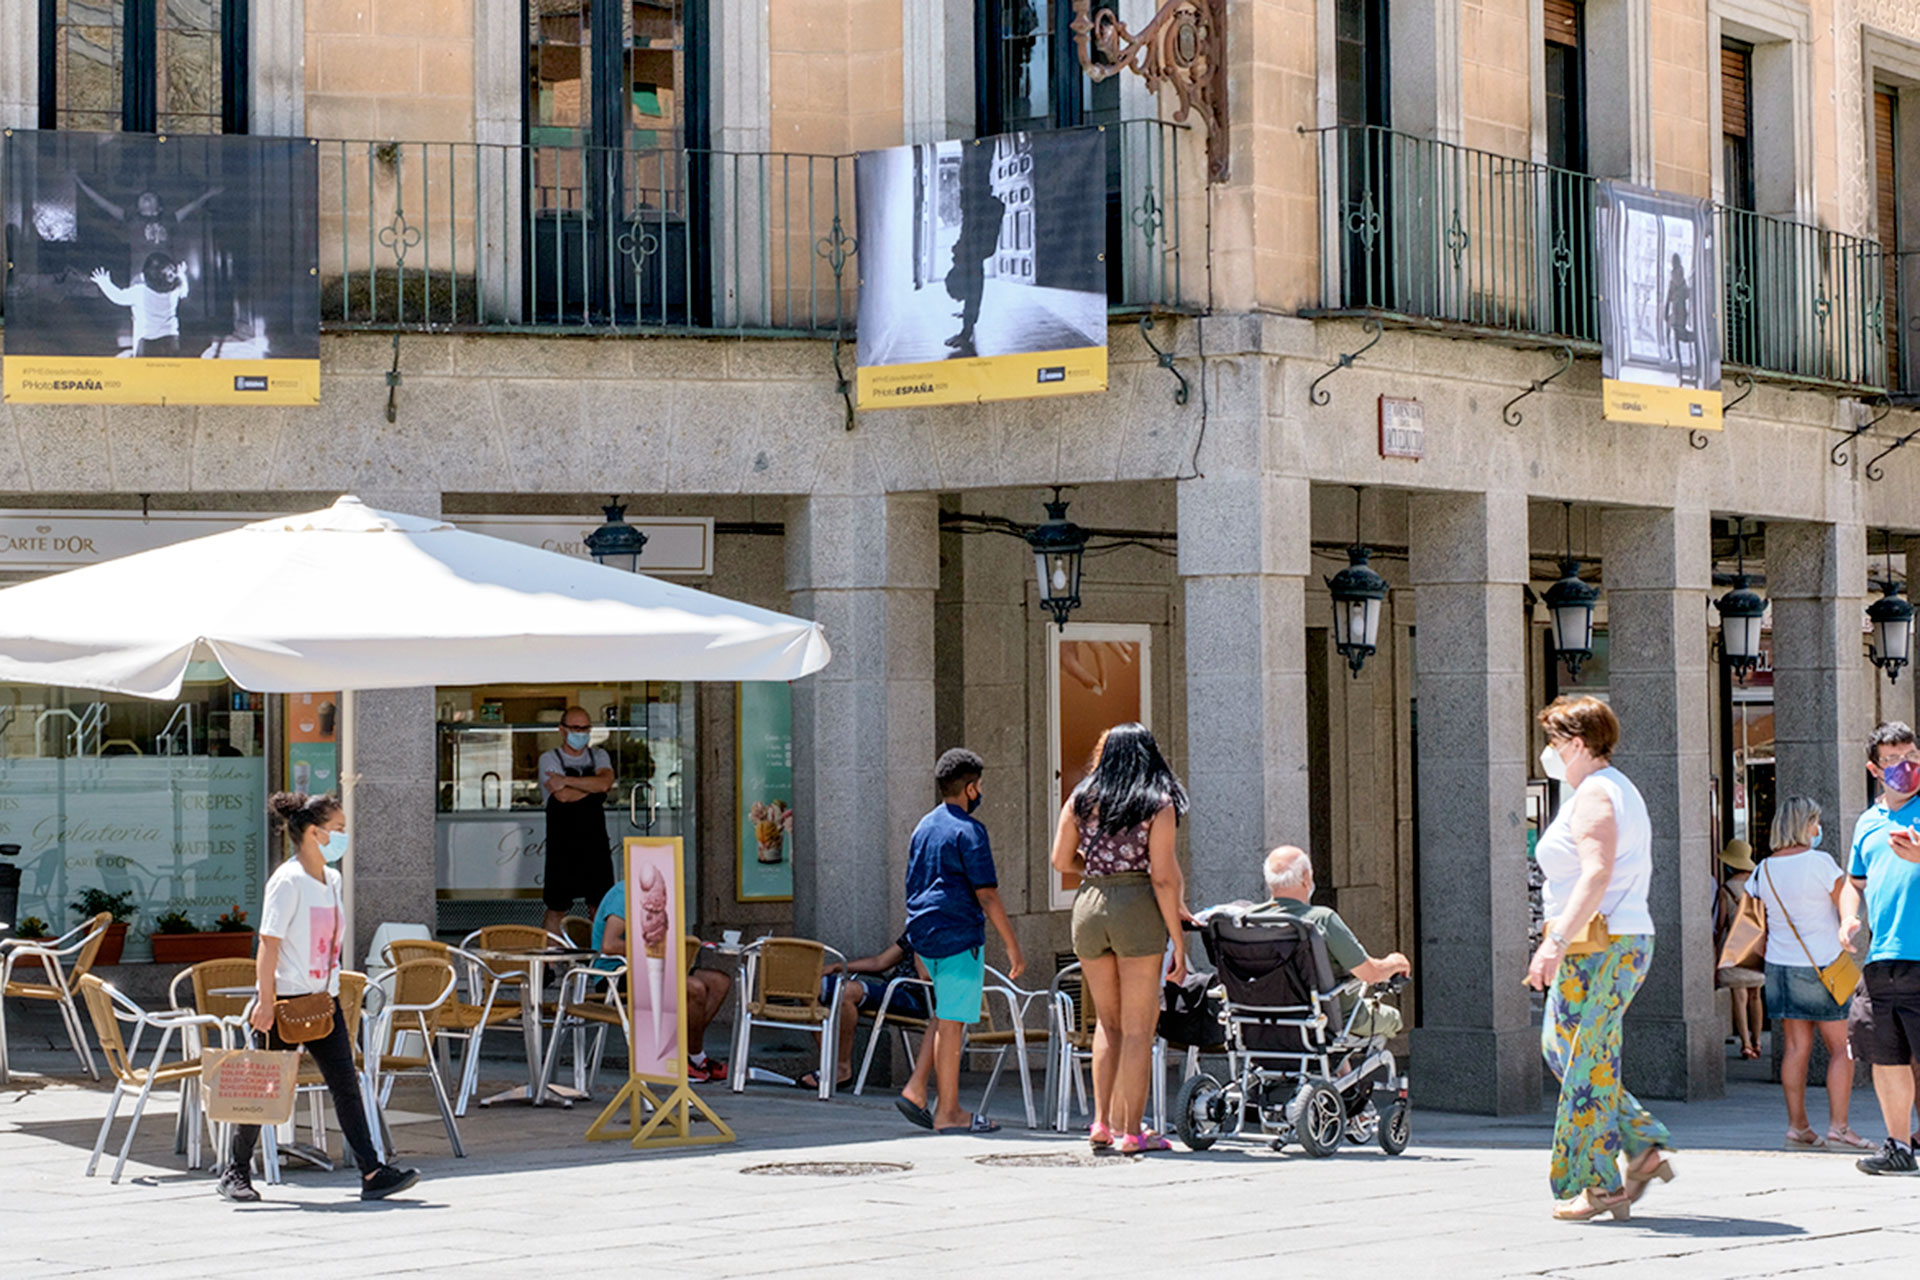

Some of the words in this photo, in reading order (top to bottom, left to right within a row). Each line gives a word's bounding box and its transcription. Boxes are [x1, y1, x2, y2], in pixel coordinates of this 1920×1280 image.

[22, 378, 103, 391] PHotoESPAÑA
[53, 535, 100, 554] D'OR
[183, 793, 243, 810] CREPES
[31, 815, 162, 851] Gelateria
[170, 841, 236, 856] WAFFLES
[167, 896, 238, 908] GRANIZADOS
[232, 1105, 264, 1114] MANGO
